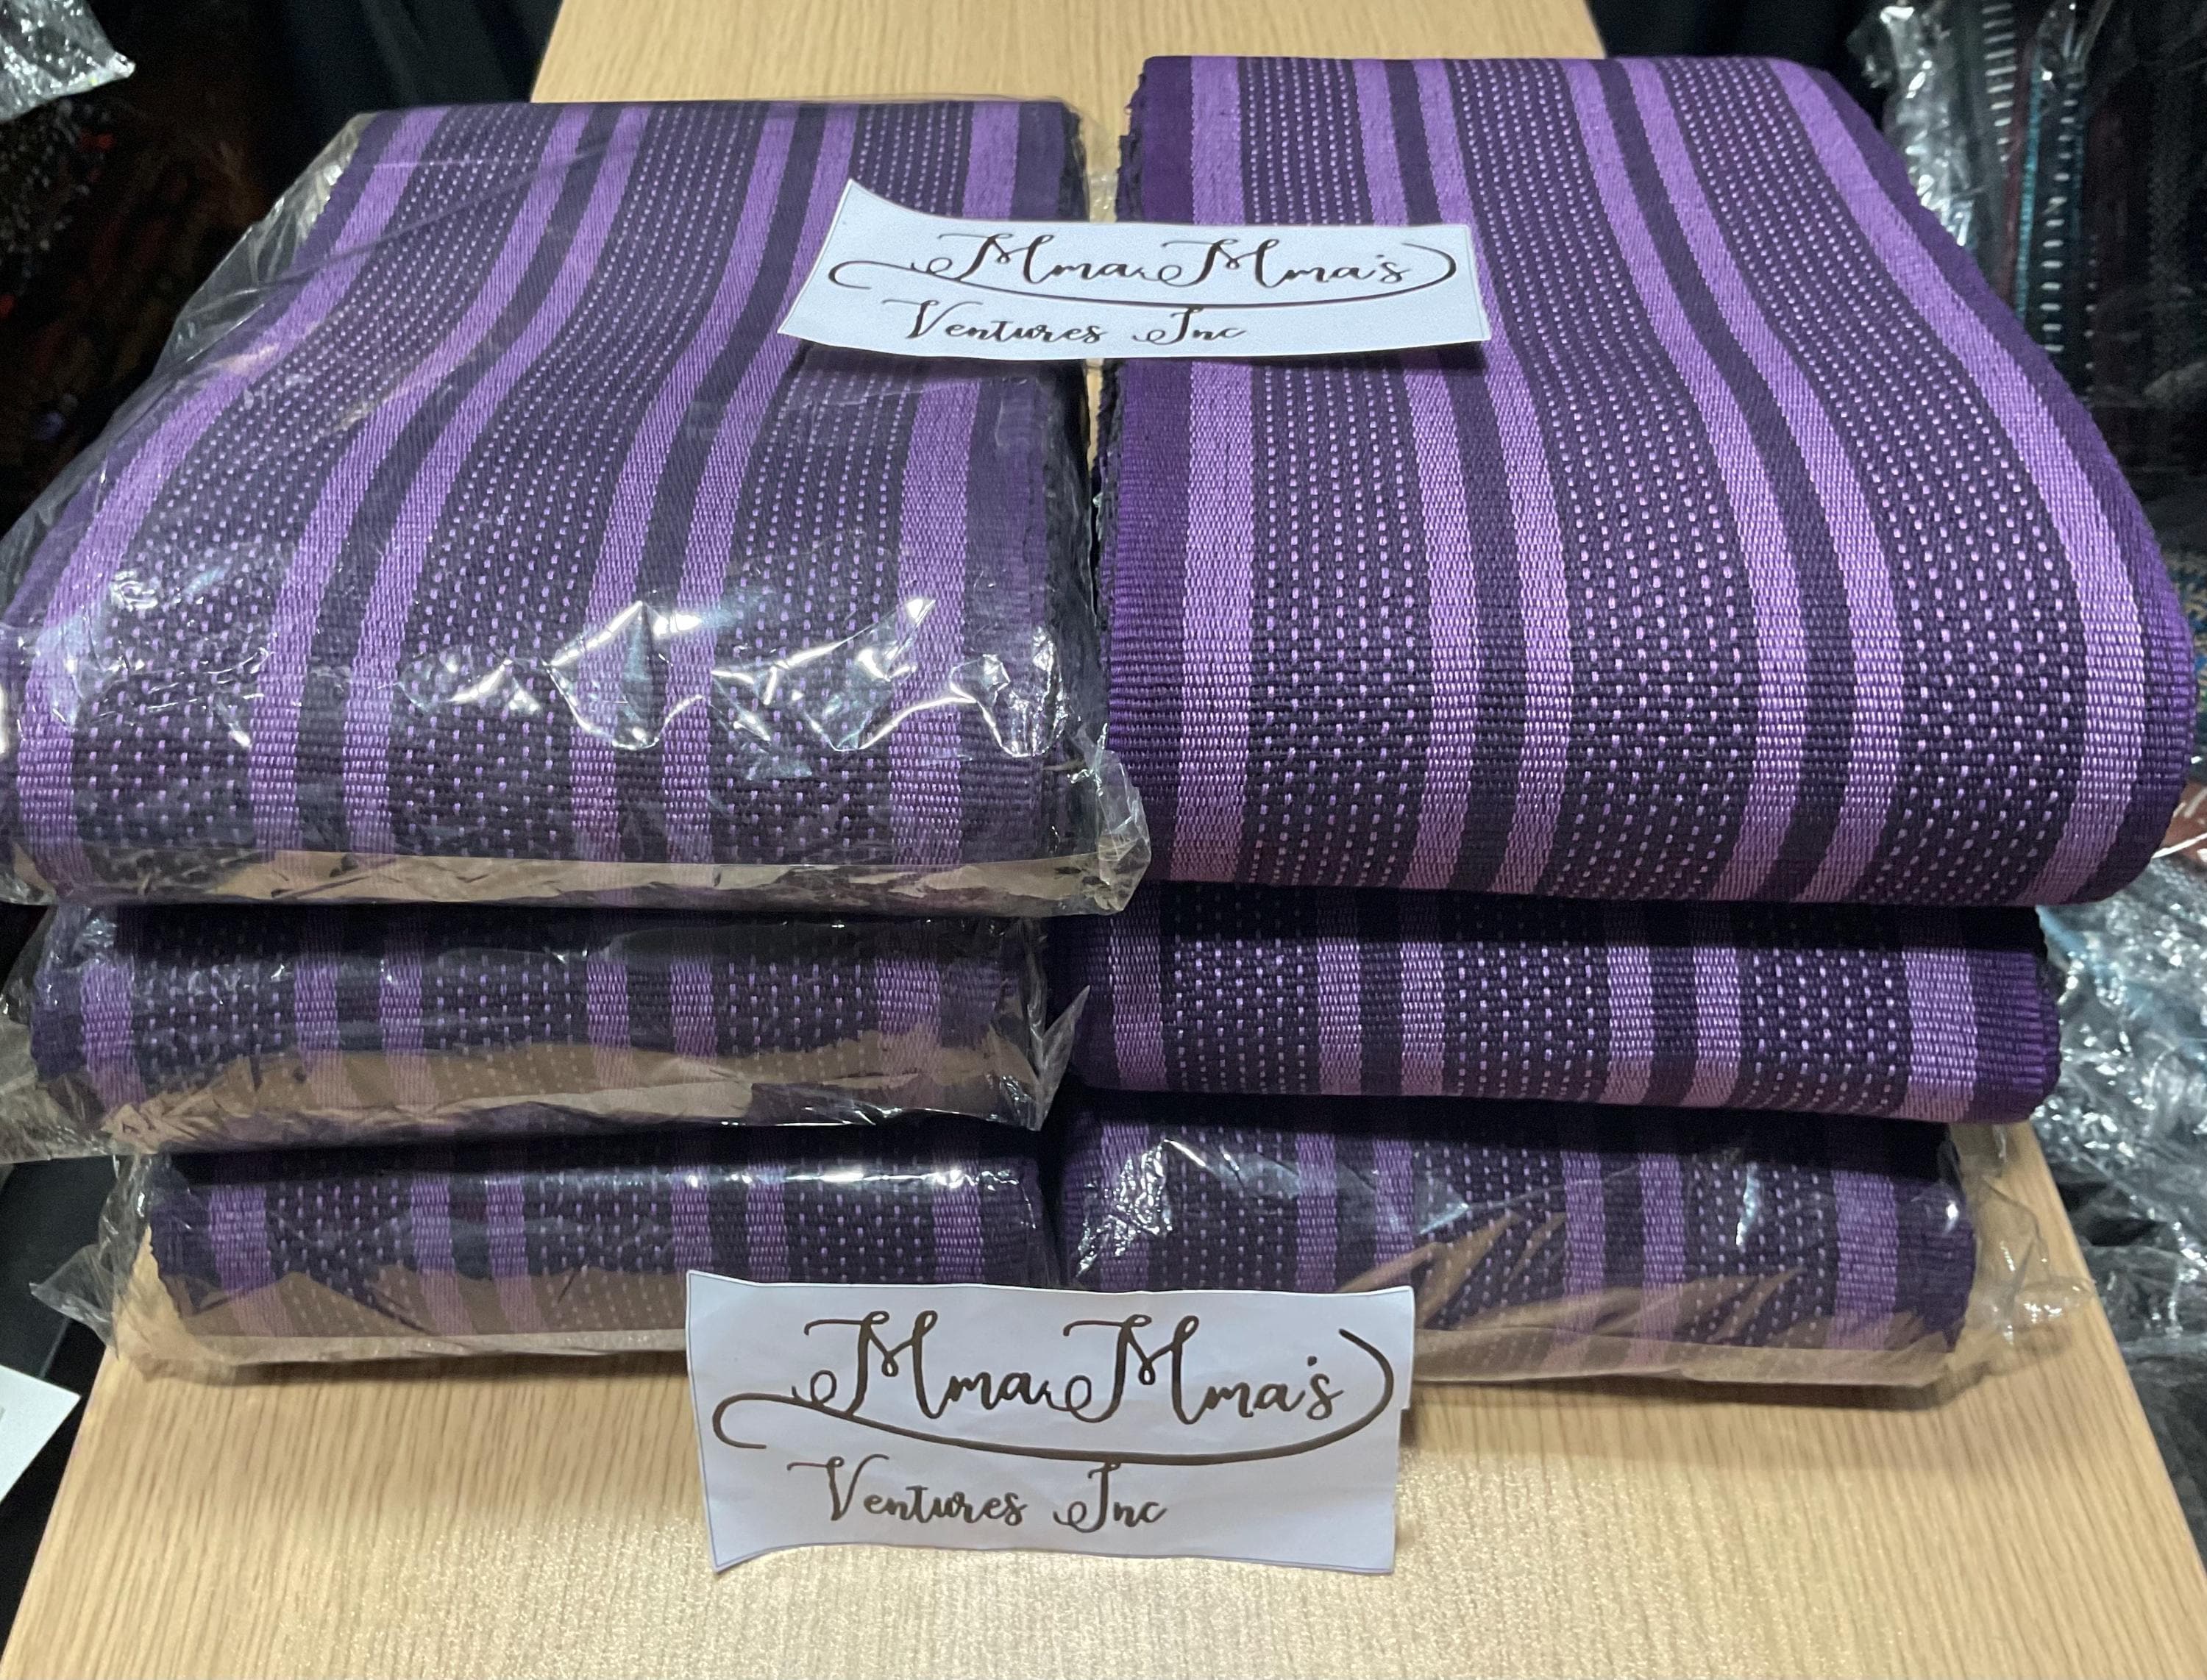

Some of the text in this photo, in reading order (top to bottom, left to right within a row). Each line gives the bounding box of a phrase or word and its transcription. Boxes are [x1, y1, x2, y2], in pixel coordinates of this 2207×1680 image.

[911, 232, 1143, 282] Mma
[881, 299, 1246, 344] Ventures Inc
[792, 1310, 1052, 1420] Mma
[786, 1453, 1167, 1534] Ventures Inc
